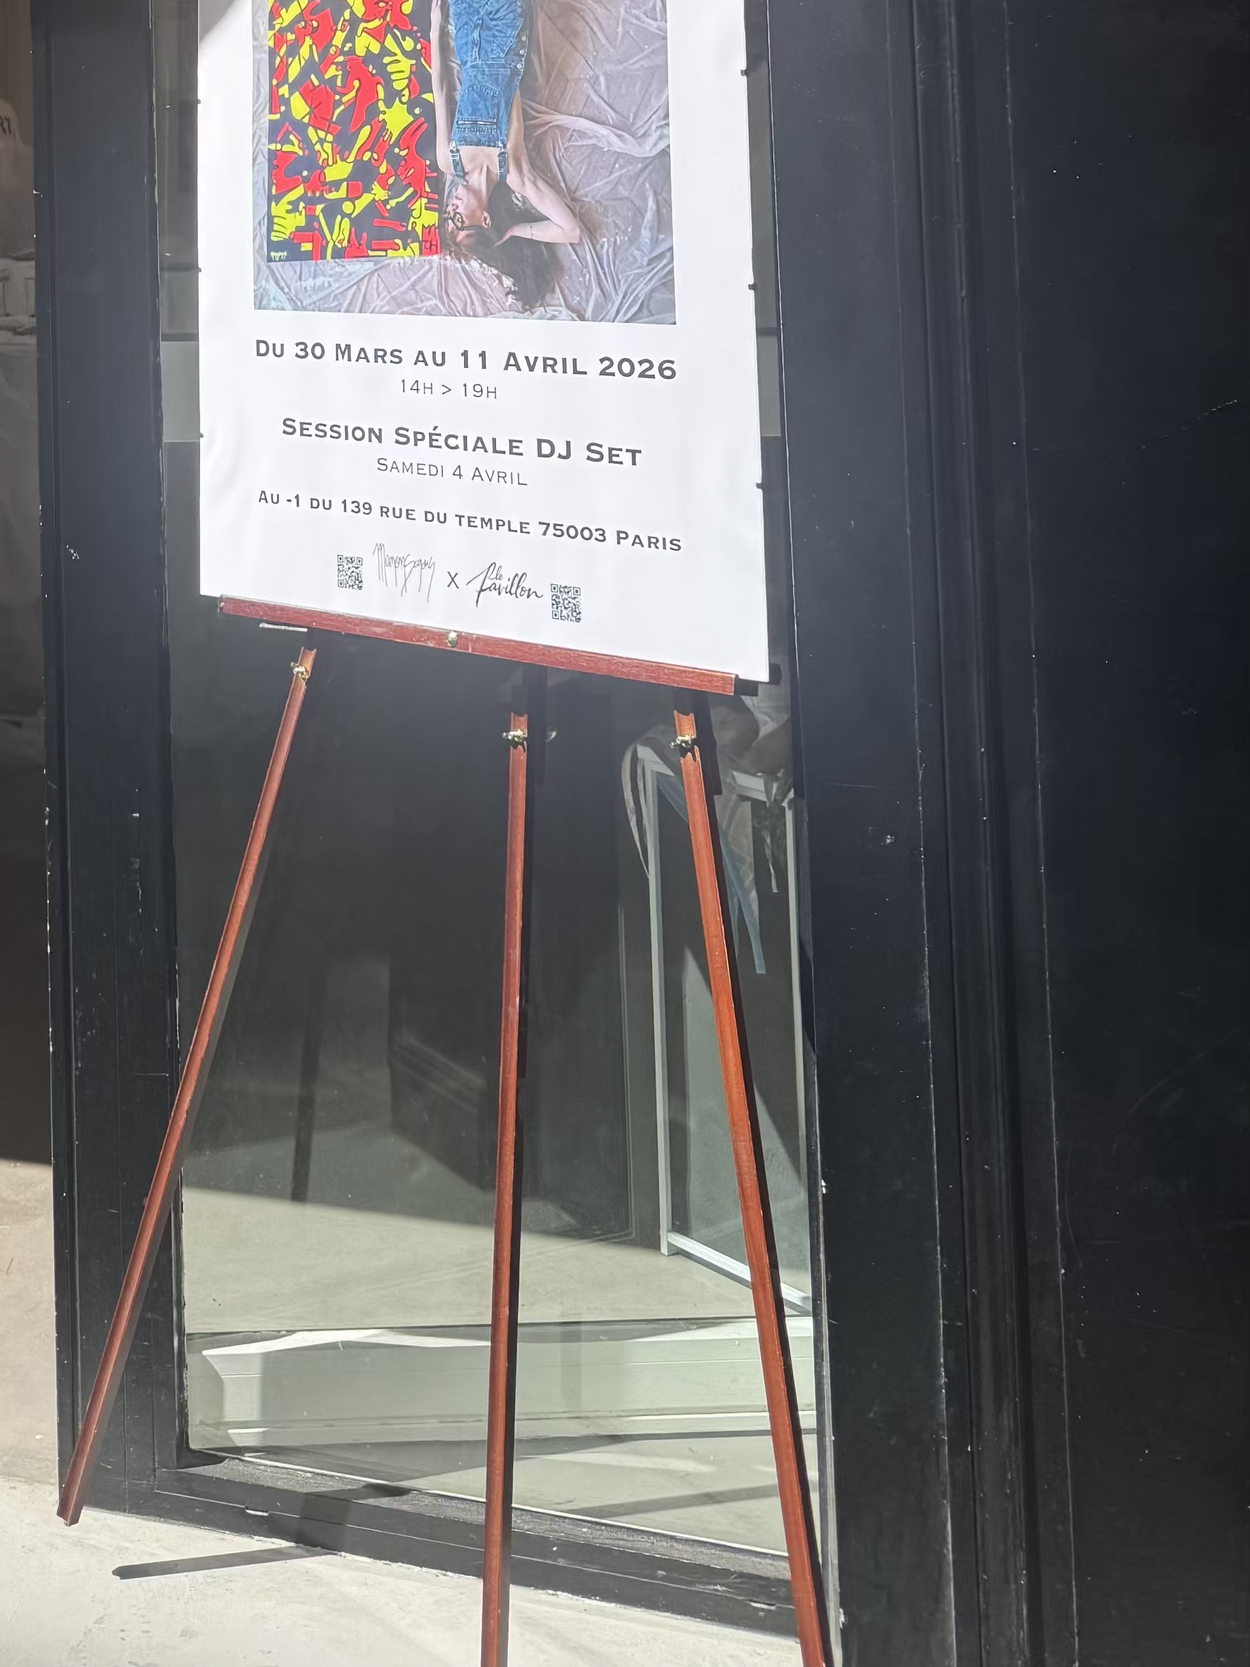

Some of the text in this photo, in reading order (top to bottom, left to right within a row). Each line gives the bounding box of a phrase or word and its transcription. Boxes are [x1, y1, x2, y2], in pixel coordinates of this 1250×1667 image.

[255, 339, 677, 380] DU 30 MARS AU 11 AVRIL 2026
[401, 378, 433, 395] 14H
[462, 382, 497, 400] 19H
[282, 417, 643, 467] SESSION SPÉCIALE DJ SET
[376, 457, 528, 487] SAMEDI 4 AVRIL
[258, 489, 682, 552] AU -1 DU 139 RUE DU TEMPLE 75003 PARIS
